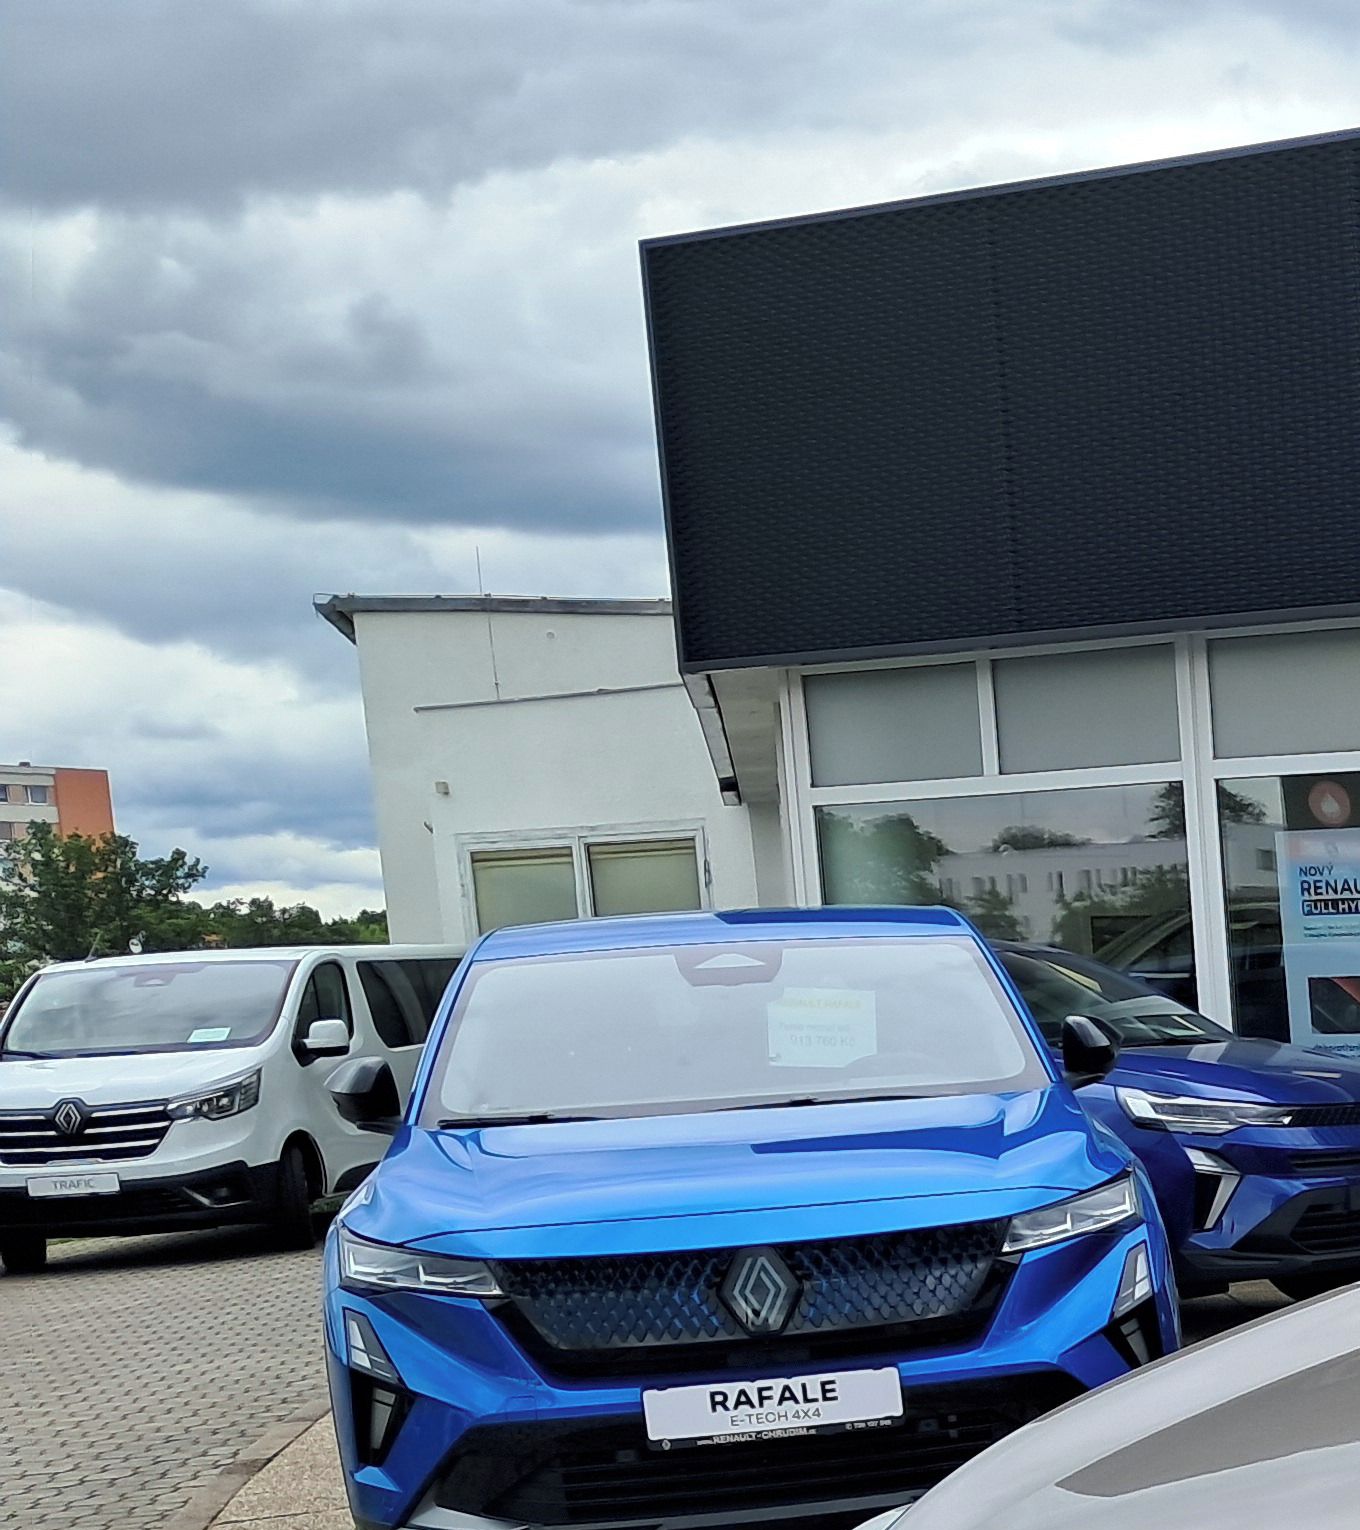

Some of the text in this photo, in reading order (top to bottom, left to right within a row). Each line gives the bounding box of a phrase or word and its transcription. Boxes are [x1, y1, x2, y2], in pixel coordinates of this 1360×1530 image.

[1299, 862, 1334, 877] NOVÝ
[1304, 901, 1337, 914] FULL
[52, 1179, 96, 1190] TRAFIC
[709, 1380, 839, 1413] RAFALE
[730, 1407, 822, 1427] E-TECH 4X4
